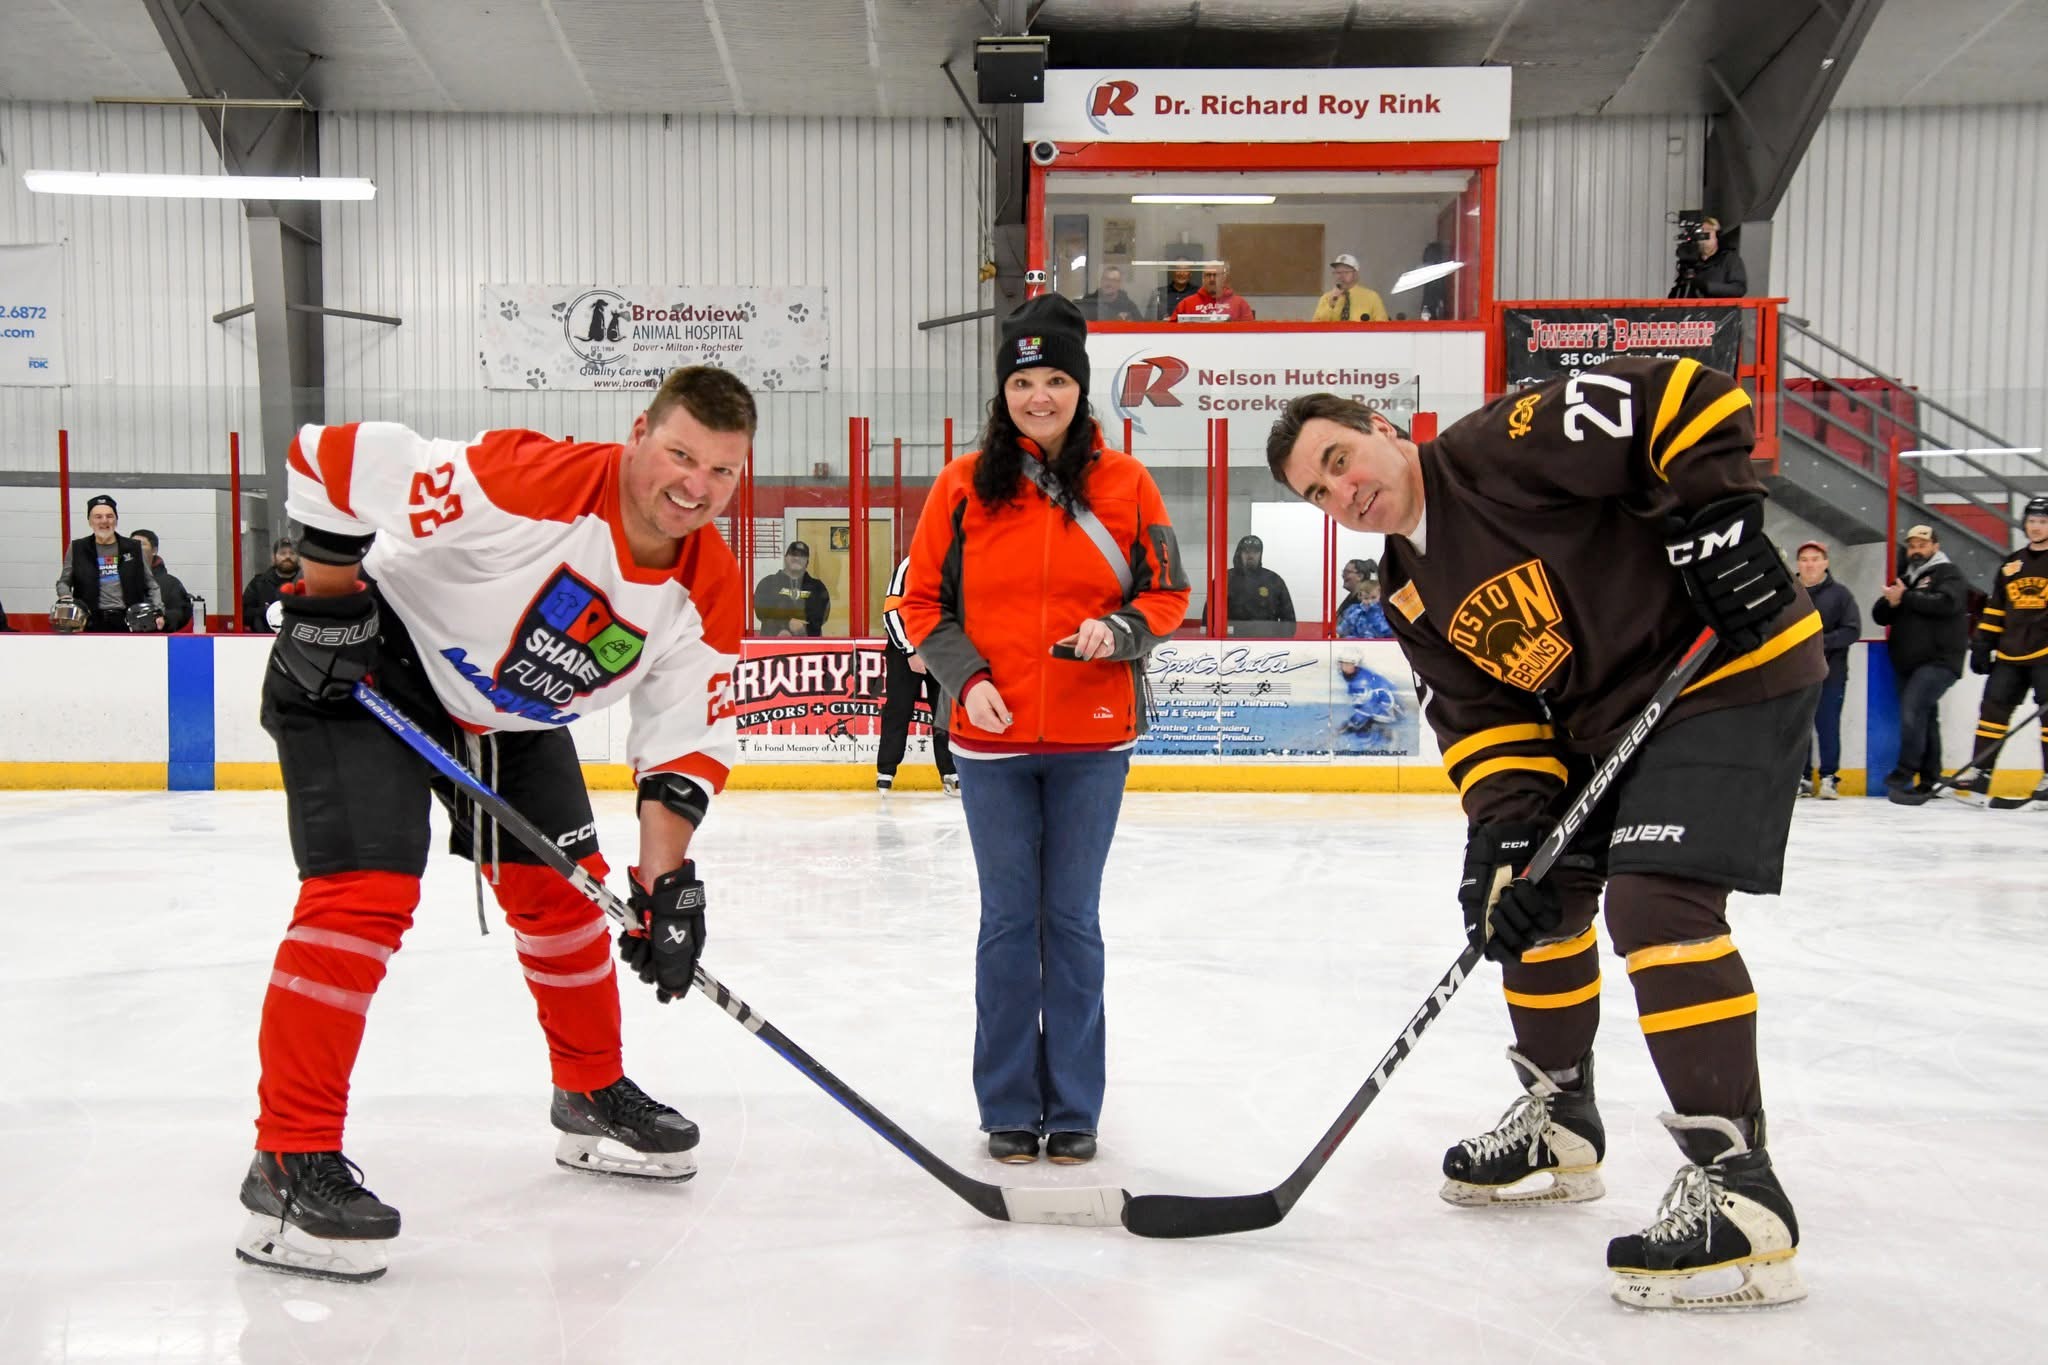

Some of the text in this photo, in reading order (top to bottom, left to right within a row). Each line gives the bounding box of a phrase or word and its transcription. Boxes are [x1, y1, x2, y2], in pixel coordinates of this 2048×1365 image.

[1154, 94, 1441, 119] Dr. Richard Roy Rink
[632, 304, 745, 322] Broadview
[633, 325, 744, 341] ANIMAL HOSPITAL
[633, 343, 744, 352] Dover Milton Rochester
[28, 360, 48, 368] FDIC
[1560, 353, 1579, 365] 35
[580, 366, 616, 377] Quality
[619, 367, 641, 376] Care
[1198, 368, 1400, 389] Nelson Hutchings
[1563, 373, 1633, 442] 27
[1512, 638, 1558, 683] BRUINS
[504, 659, 574, 704] FUND
[737, 655, 850, 700] RWAY
[738, 705, 806, 727] VEYORS
[831, 703, 879, 715] CIVIL
[1151, 724, 1250, 733] Printing Embroidery
[754, 744, 762, 752] In
[764, 743, 784, 752] Fond
[786, 744, 819, 753] Memory
[821, 743, 830, 752] of
[832, 744, 852, 752] ART
[1552, 702, 1661, 856] JETSPEED
[1501, 841, 1529, 849] CCM
[1370, 962, 1465, 1091] CCM
